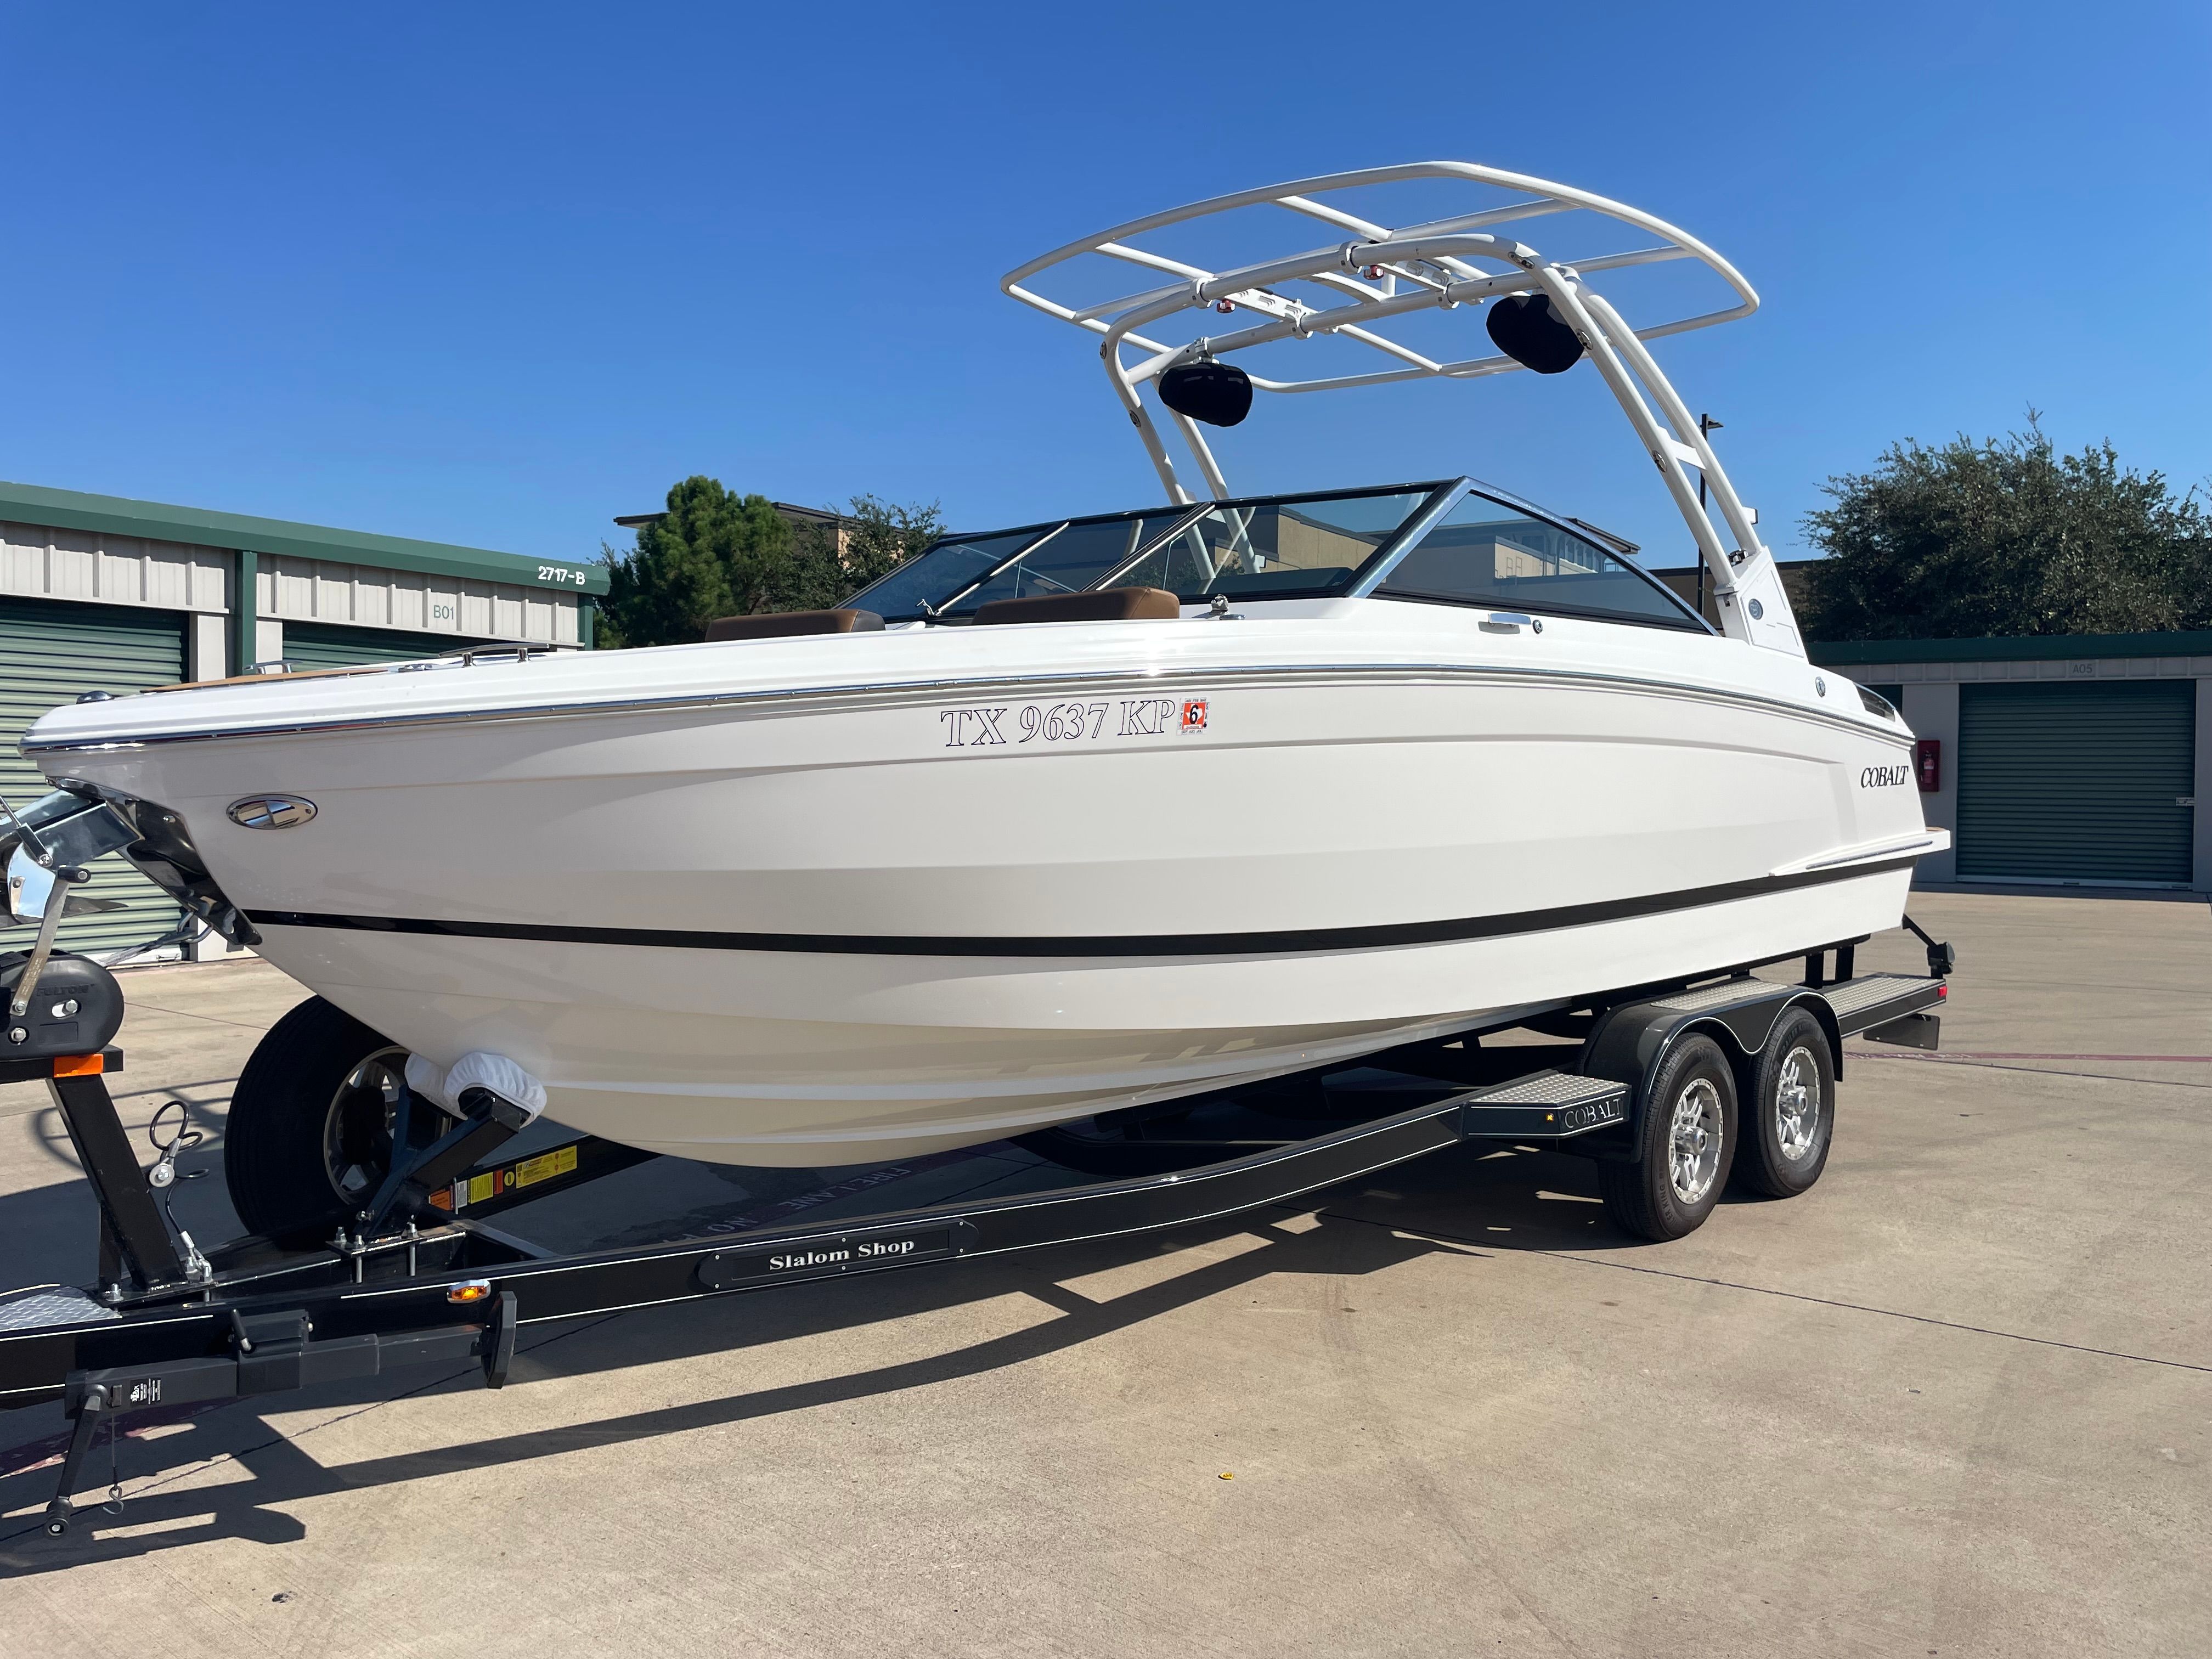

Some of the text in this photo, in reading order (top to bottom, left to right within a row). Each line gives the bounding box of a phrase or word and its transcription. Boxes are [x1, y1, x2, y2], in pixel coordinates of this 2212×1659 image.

[538, 566, 585, 585] 2717-B
[433, 605, 454, 619] B01
[2073, 664, 2092, 674] A05
[940, 708, 1008, 747] TX
[1019, 703, 1109, 743] 9637
[1117, 699, 1176, 736] KP
[1189, 704, 1199, 725] 6
[1860, 765, 1909, 788] COBALT
[1565, 1098, 1621, 1128] COBALT
[769, 1240, 915, 1271] Slalom Shop
